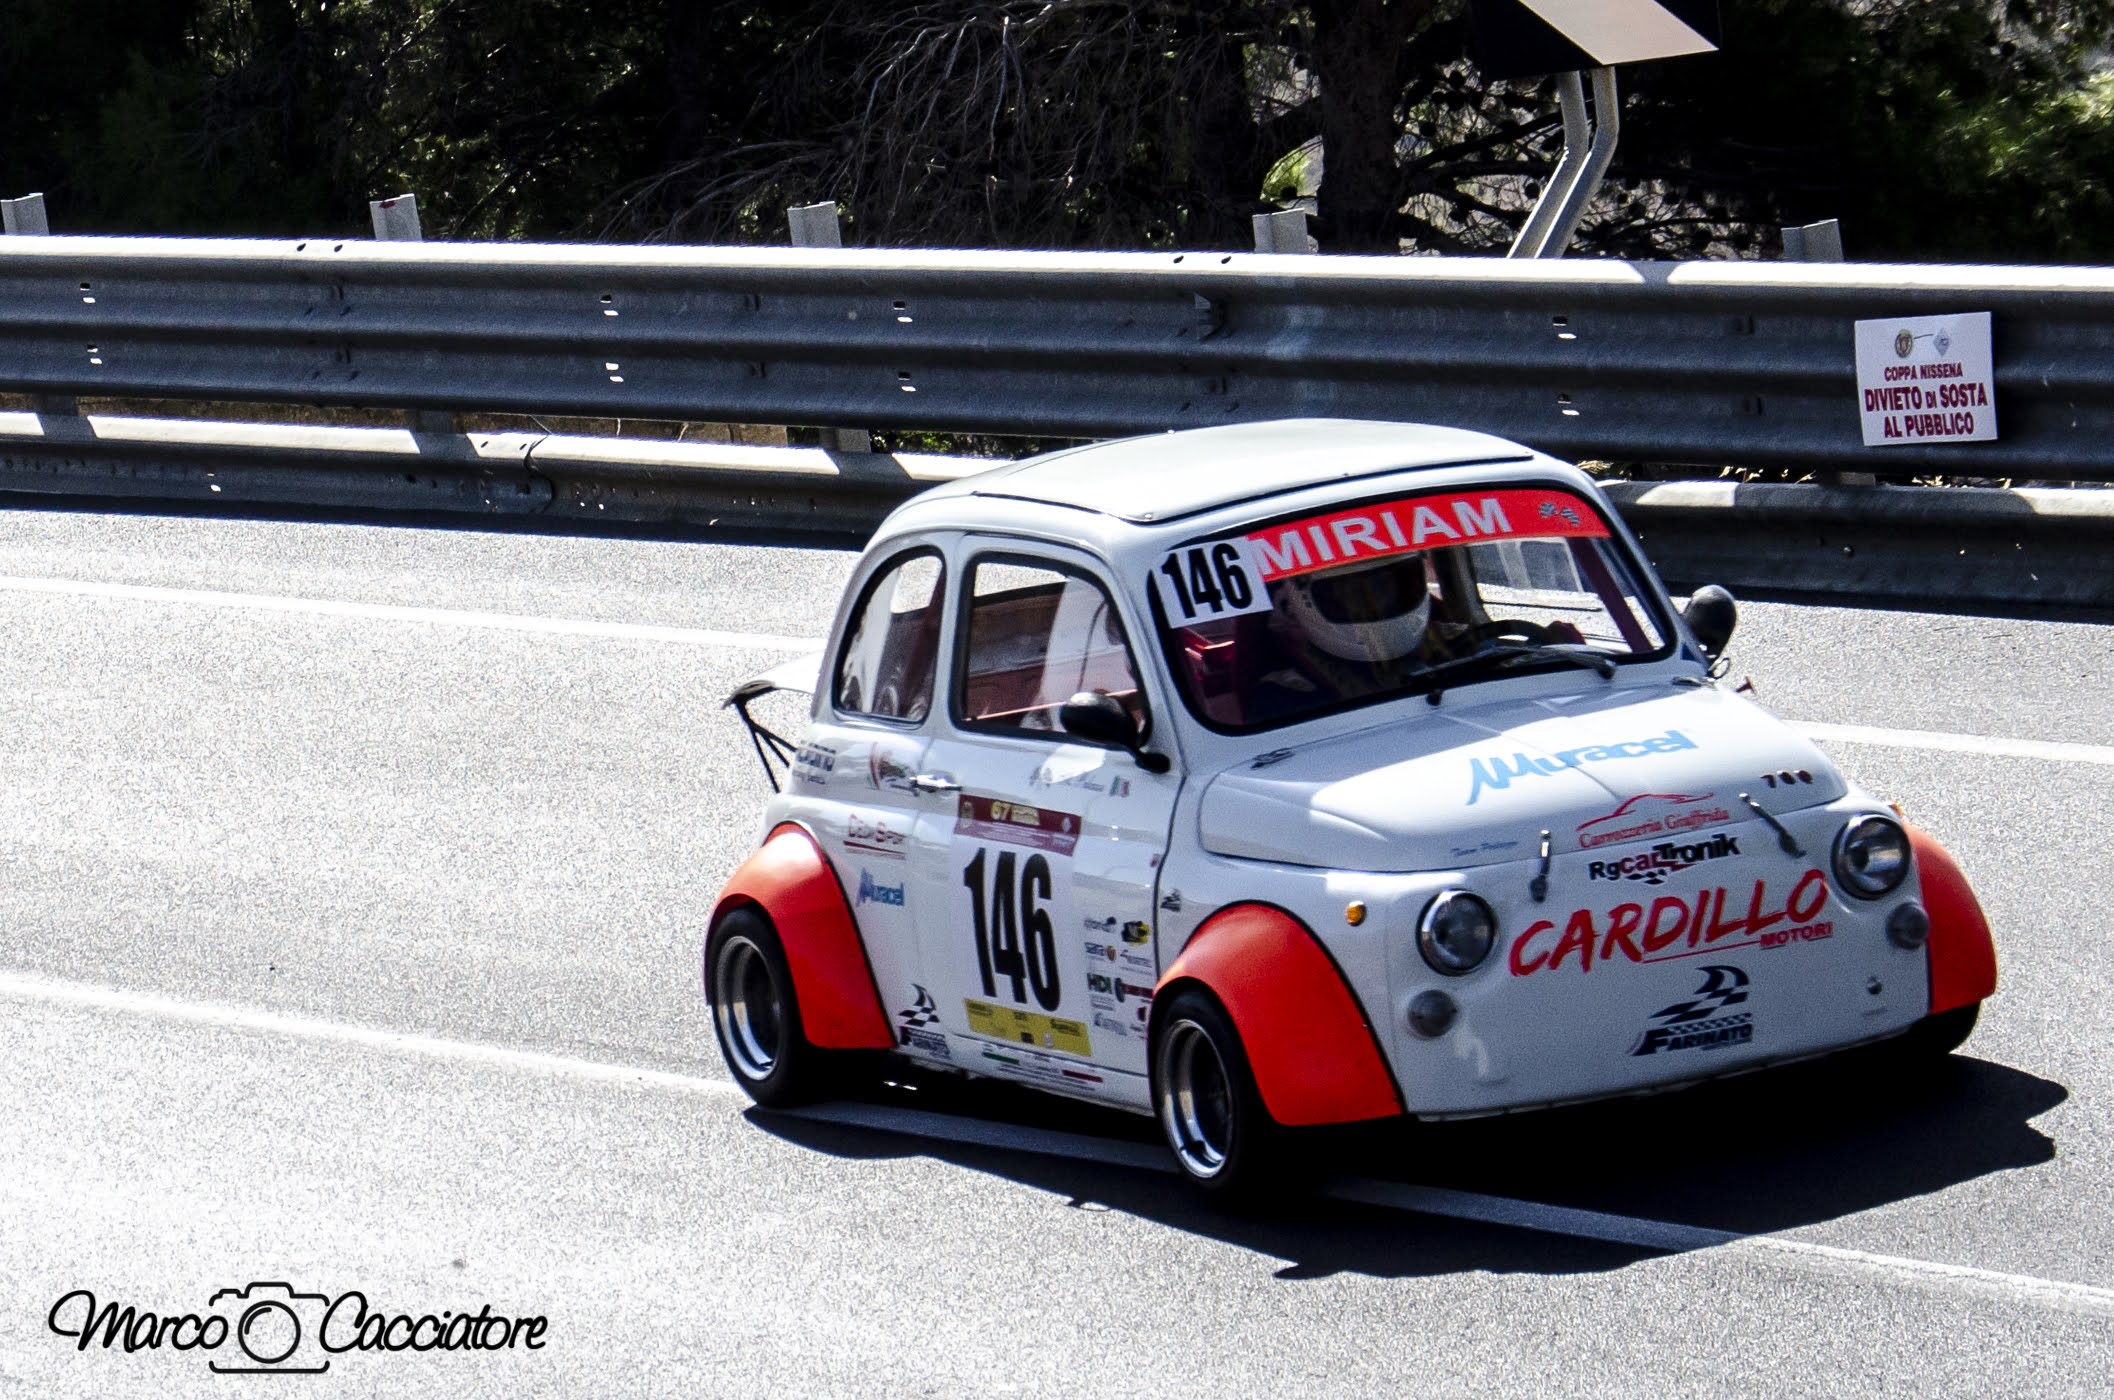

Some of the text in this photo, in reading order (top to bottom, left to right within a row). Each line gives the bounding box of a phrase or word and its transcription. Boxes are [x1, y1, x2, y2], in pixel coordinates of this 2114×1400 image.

[1864, 382, 1989, 412] DIVIETO DI SOSTA
[1884, 362, 1964, 382] COPPA NISSENA
[1884, 412, 1975, 438] AL PUBBLICO
[1250, 497, 1513, 576] MIRIAM
[1161, 542, 1253, 620] 146
[1466, 730, 1699, 806] Muracel
[963, 847, 1061, 1012] 146
[1508, 868, 1829, 977] CARDILLO
[1759, 922, 1834, 947] MOTORI
